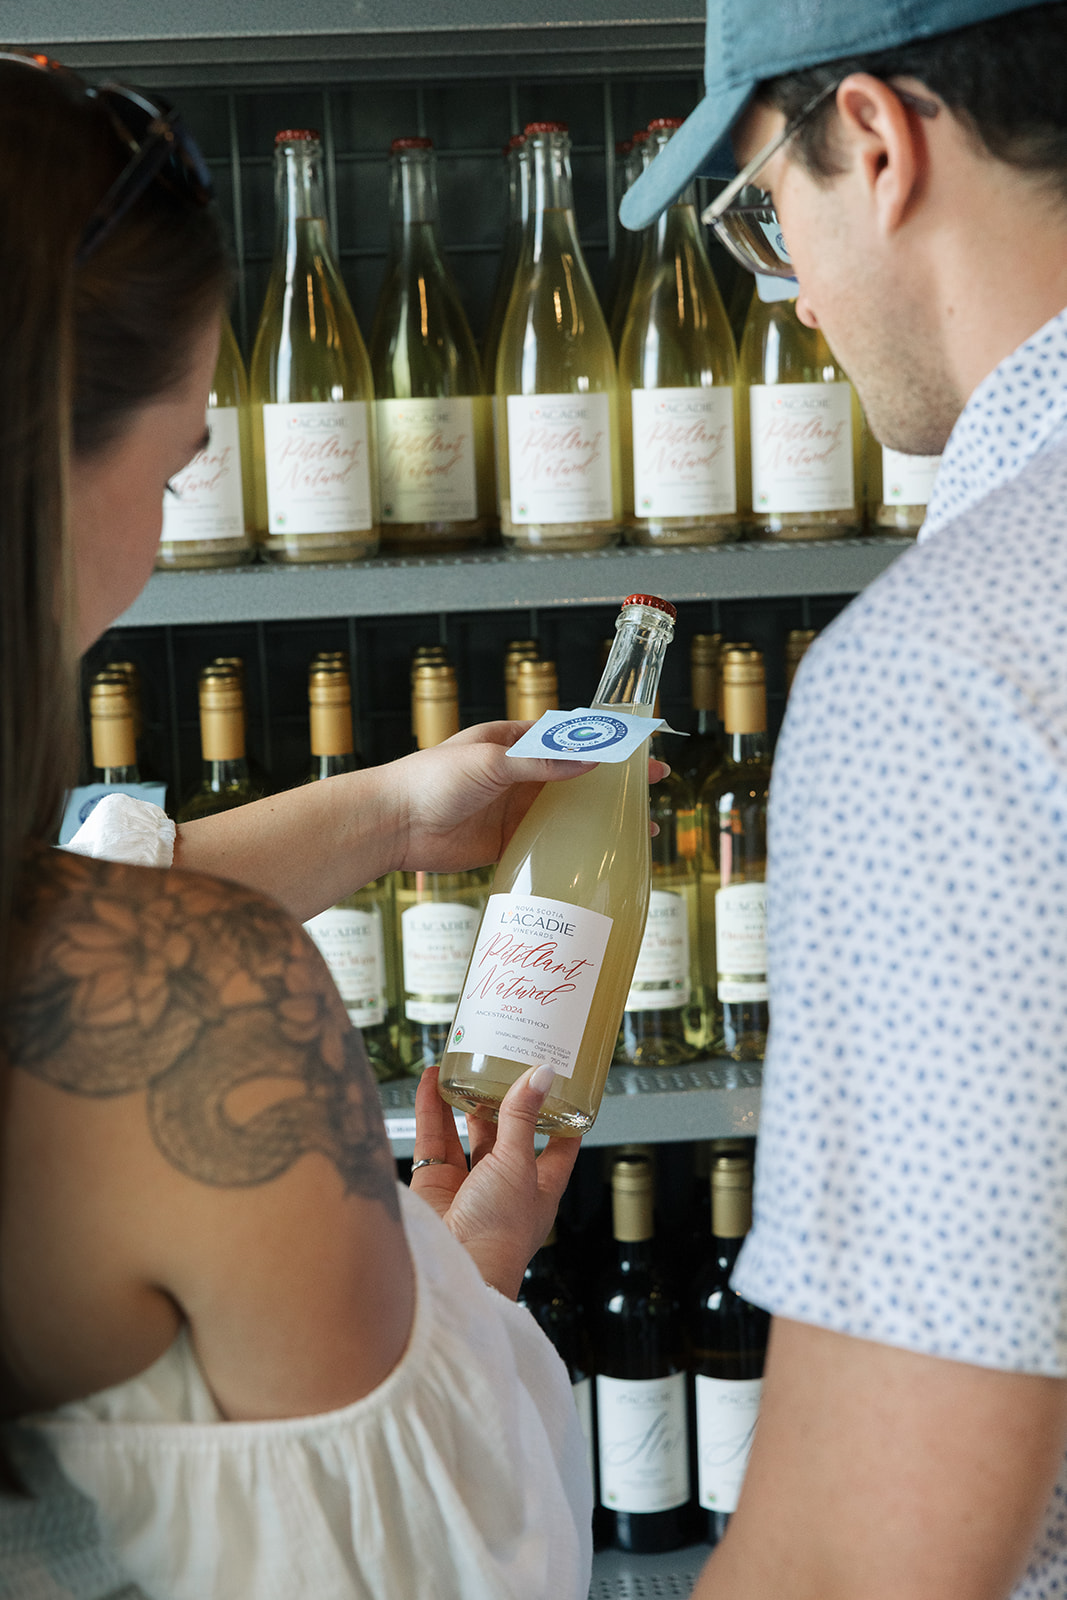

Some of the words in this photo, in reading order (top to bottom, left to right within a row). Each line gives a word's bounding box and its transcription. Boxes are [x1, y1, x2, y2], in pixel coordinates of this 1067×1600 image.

[515, 905, 534, 913] NOVA
[537, 908, 564, 919] SCOTIA
[513, 927, 554, 940] VINEYARDS
[467, 964, 577, 1006] Naturel
[501, 1004, 522, 1014] 2024
[475, 1010, 514, 1021] ANCESTRAL
[515, 1016, 550, 1030] METHOD
[534, 1045, 553, 1055] Organic
[550, 1057, 560, 1066] 750
